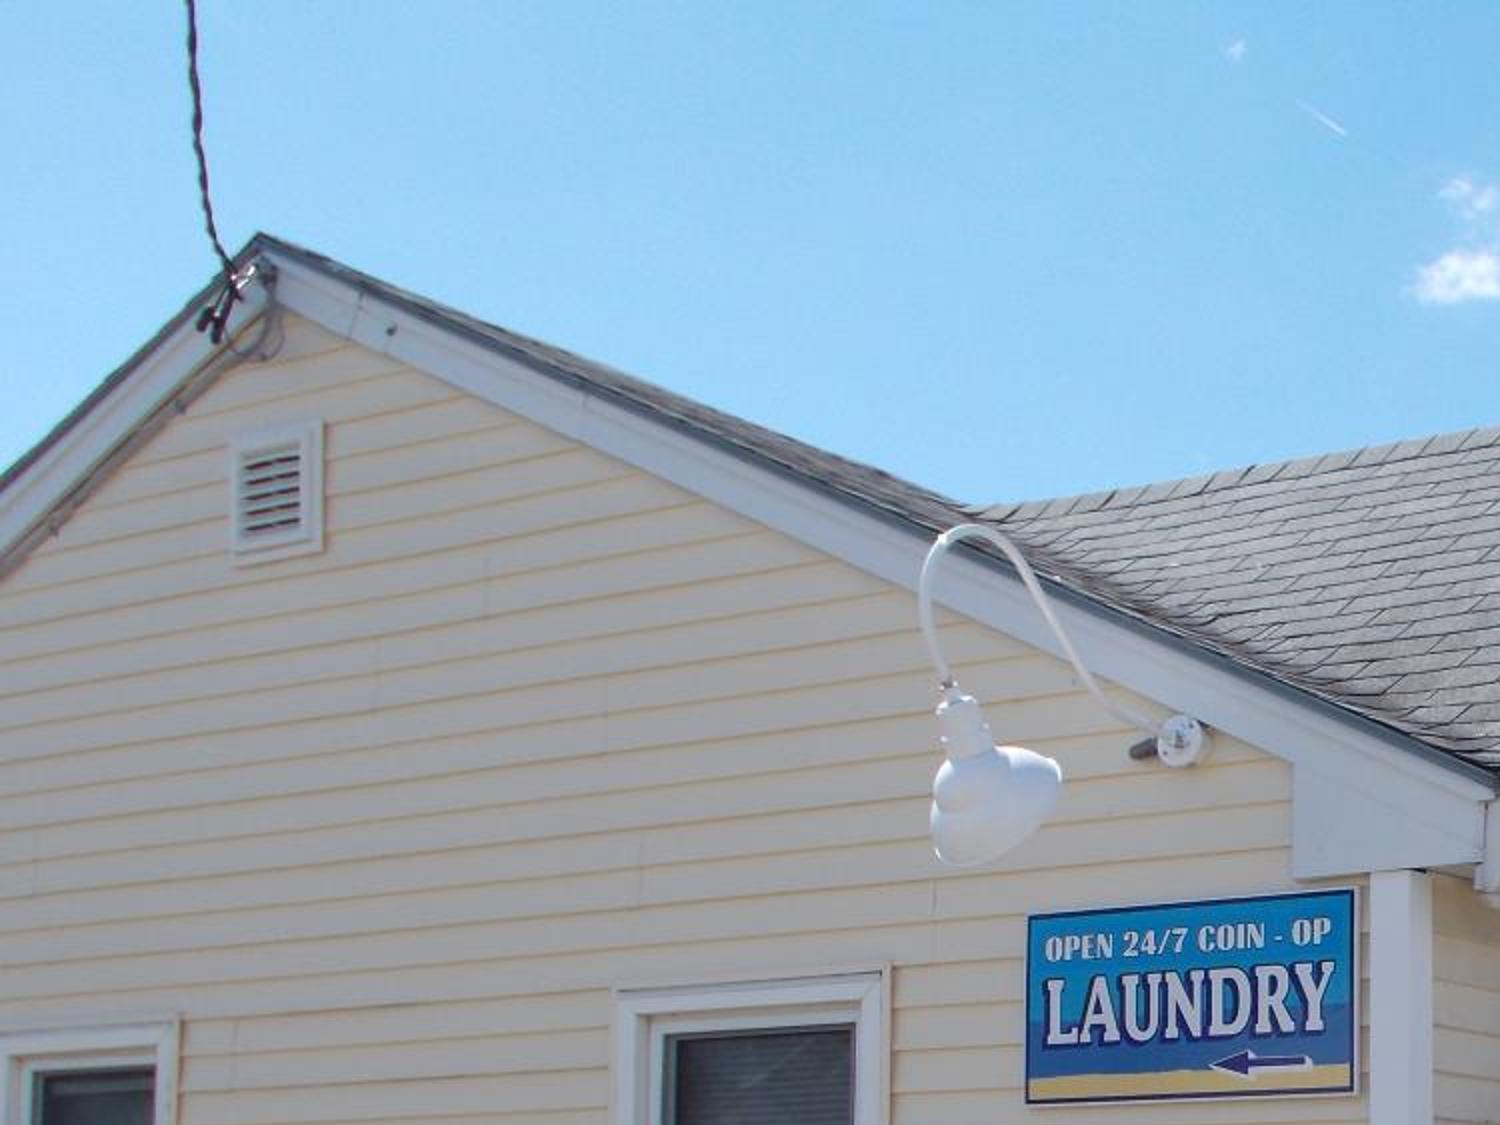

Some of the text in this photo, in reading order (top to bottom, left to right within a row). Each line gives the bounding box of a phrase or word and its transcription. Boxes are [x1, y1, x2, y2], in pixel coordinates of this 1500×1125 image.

[1045, 934, 1113, 962] OPEN
[1123, 927, 1188, 957] 24/7
[1199, 921, 1265, 952] COIN
[1292, 917, 1331, 947] OP
[1044, 961, 1336, 1049] LAUNDRY
